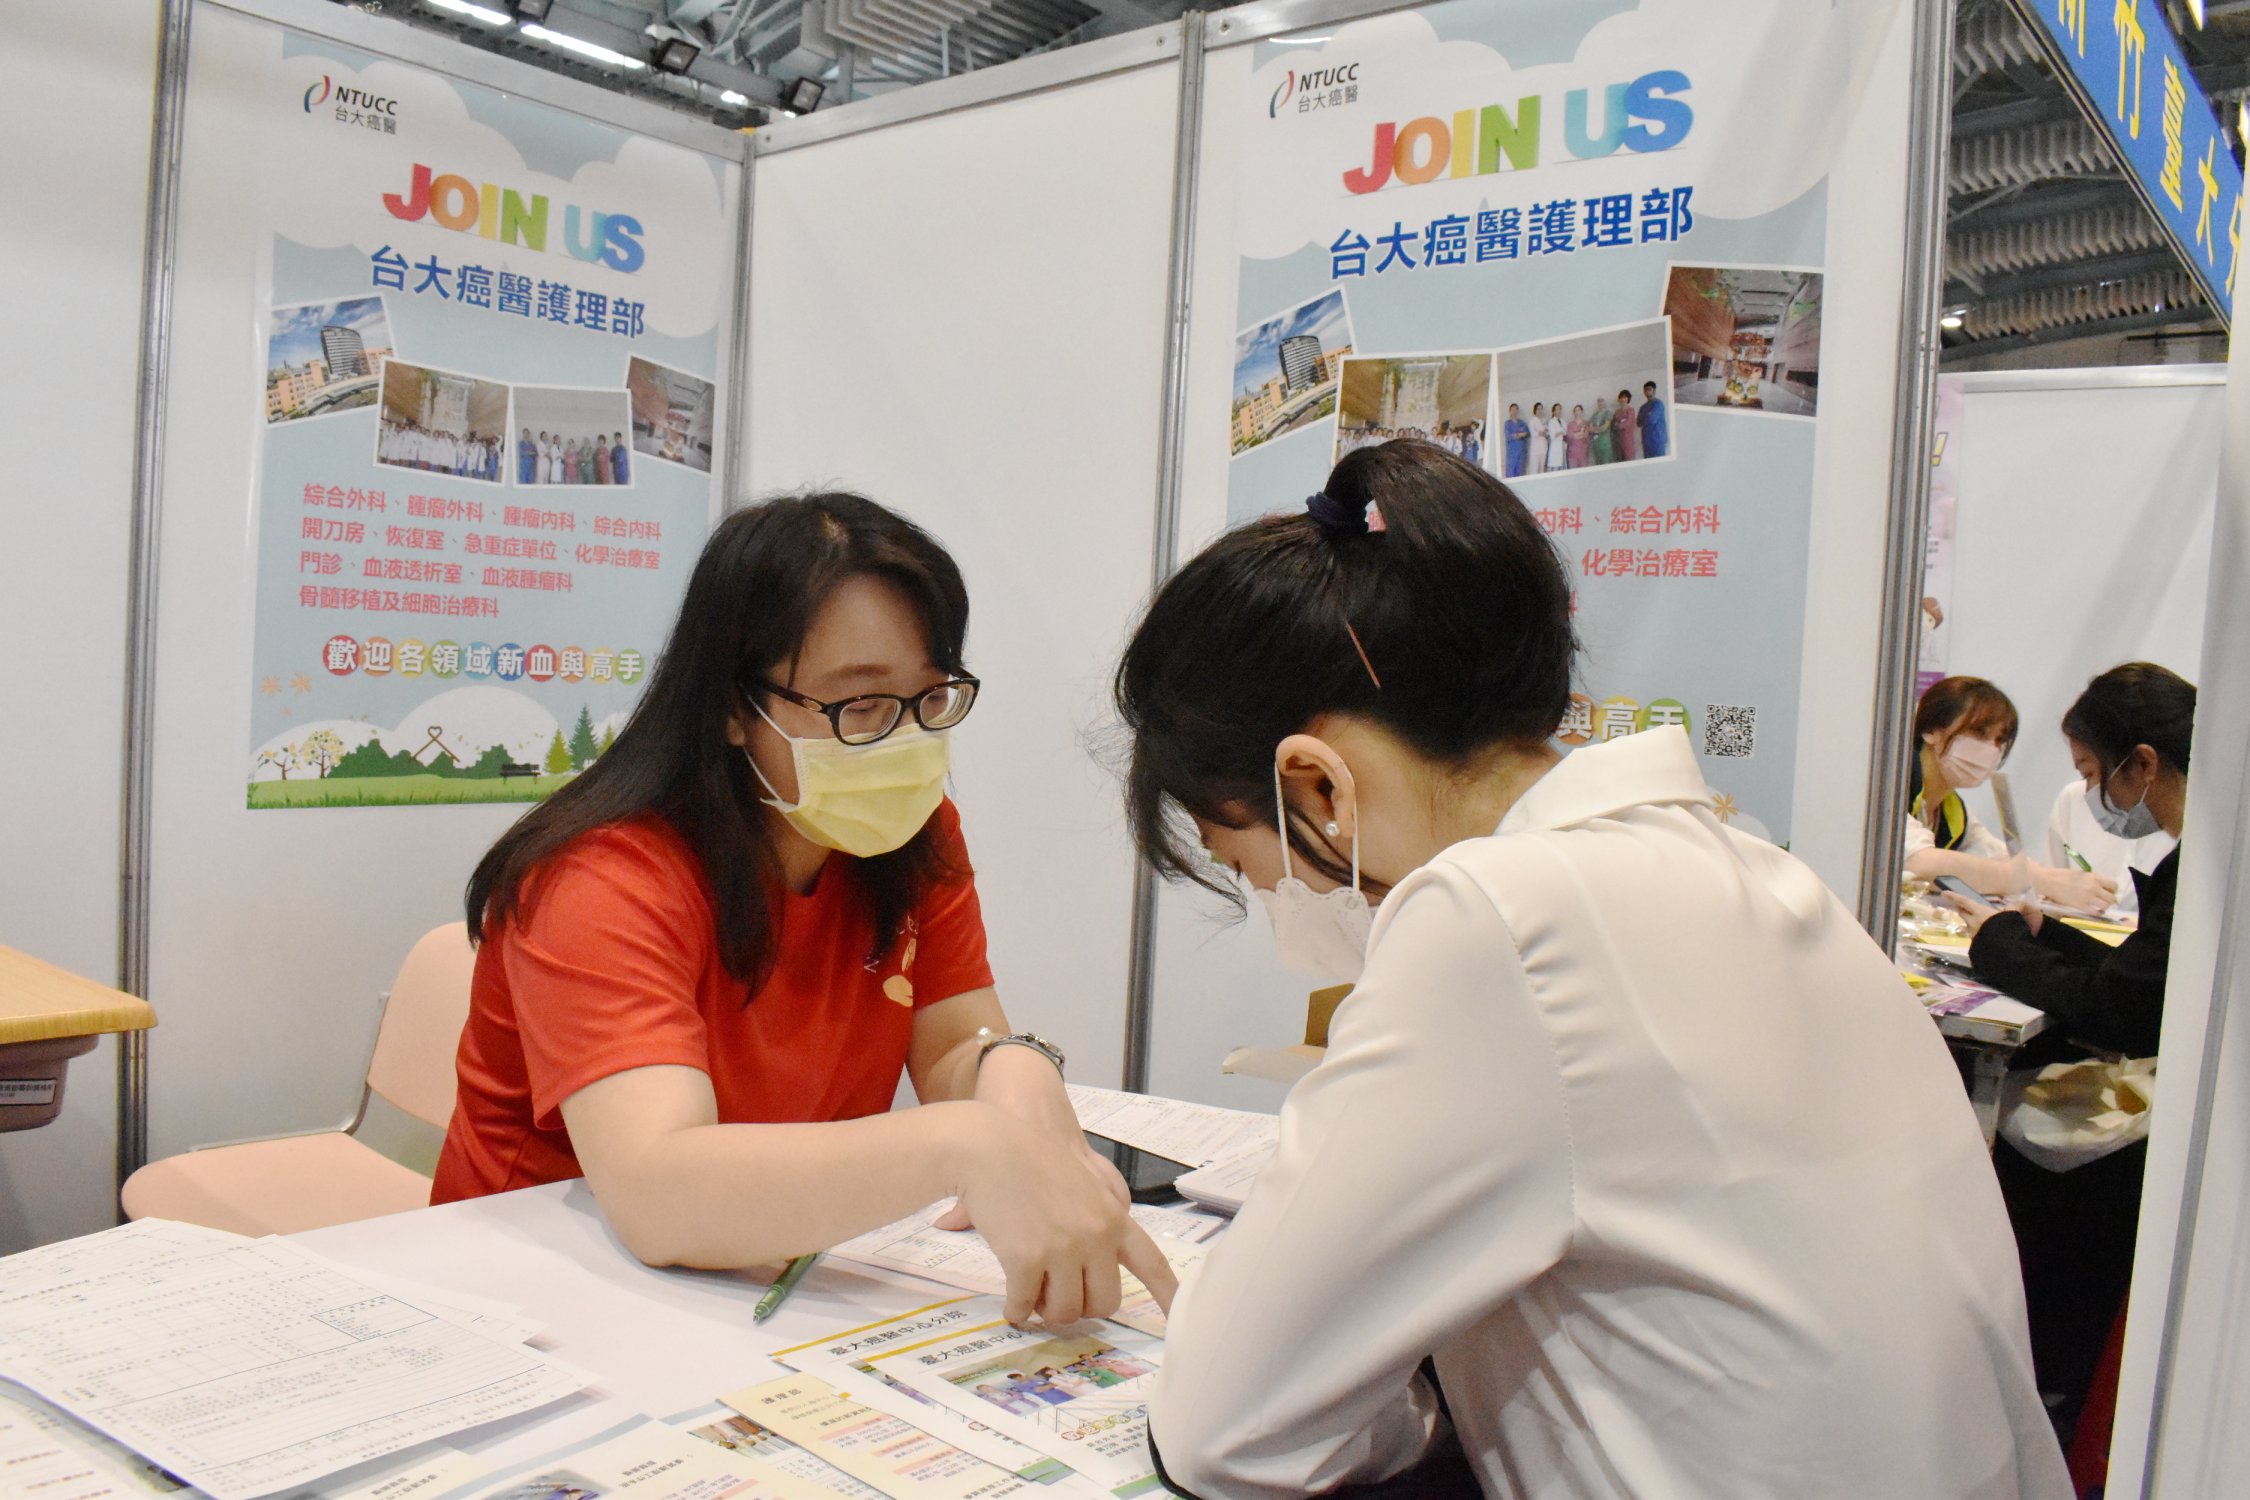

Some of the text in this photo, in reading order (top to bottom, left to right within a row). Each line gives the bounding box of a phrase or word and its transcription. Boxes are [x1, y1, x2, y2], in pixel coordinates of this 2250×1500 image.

[1297, 86, 1359, 114] 台大癌醫
[1299, 63, 1360, 94] NTUCC
[335, 86, 399, 116] NTUCC
[335, 105, 398, 135] 台大癌醫
[1341, 69, 1694, 195] JOIN US
[382, 162, 646, 274] JOIN US
[1329, 185, 1695, 280] 台大癌醫護理部
[370, 244, 646, 339] 台大癌醫護理部
[326, 637, 643, 681] 歡迎各領域新血與高手
